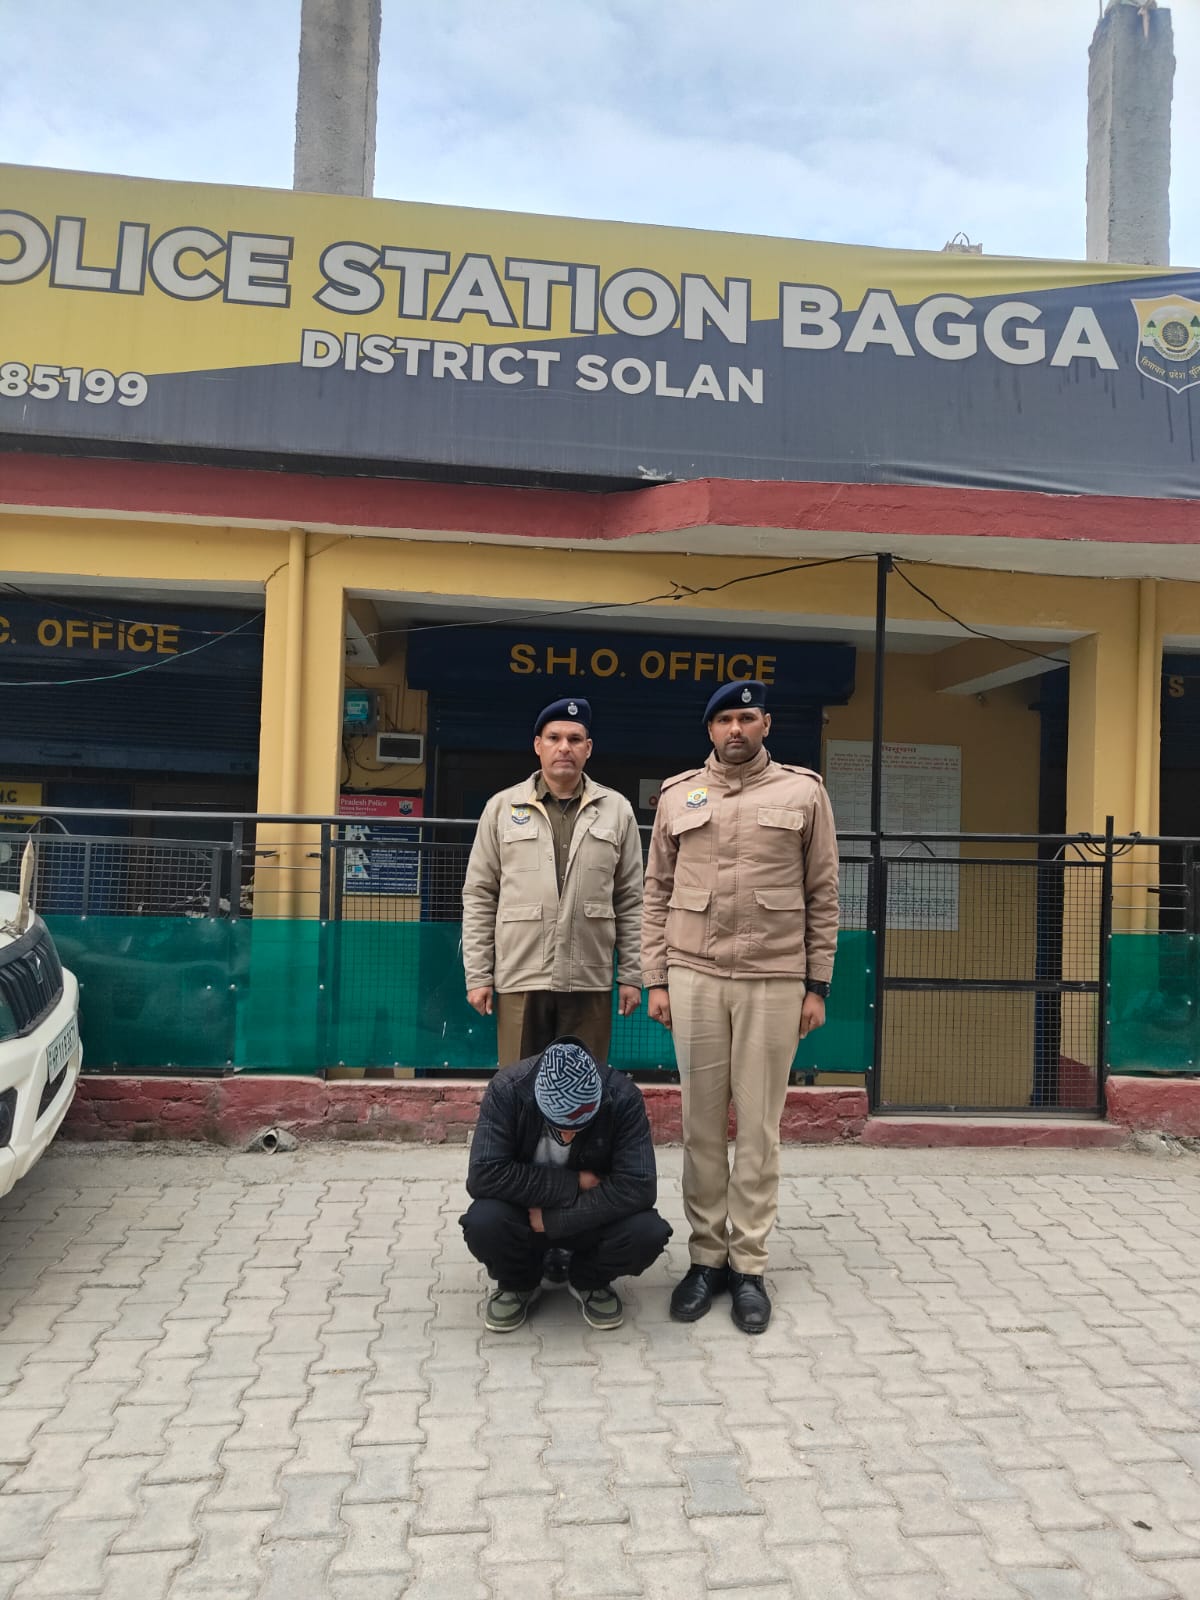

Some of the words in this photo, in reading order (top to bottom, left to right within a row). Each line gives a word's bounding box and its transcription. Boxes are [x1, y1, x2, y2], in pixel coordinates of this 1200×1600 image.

[313, 241, 752, 345] STATION
[779, 281, 1119, 371] BAGGA
[0, 362, 148, 406] 85199
[301, 328, 560, 387] DISTRICT
[575, 354, 764, 404] SOLAN
[37, 618, 180, 654] OFFICE
[509, 643, 626, 677] S.H.O.
[640, 650, 777, 685] OFFICE
